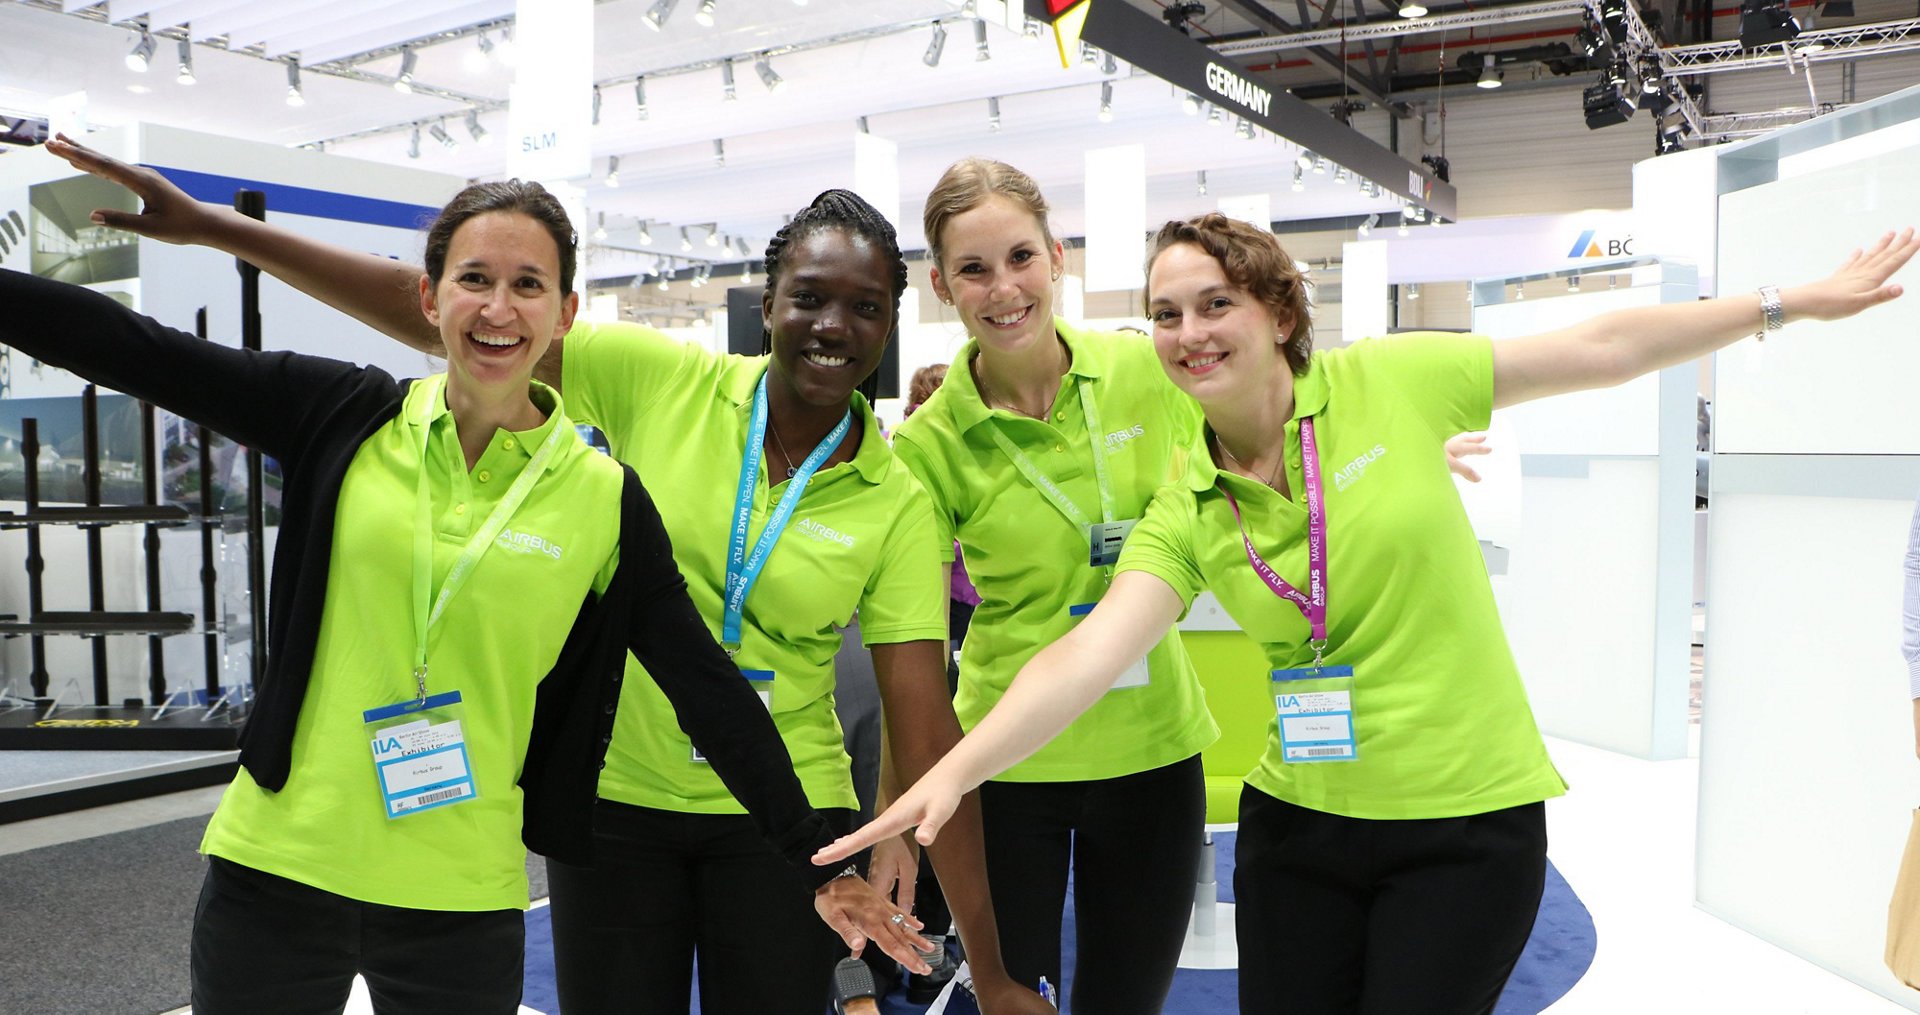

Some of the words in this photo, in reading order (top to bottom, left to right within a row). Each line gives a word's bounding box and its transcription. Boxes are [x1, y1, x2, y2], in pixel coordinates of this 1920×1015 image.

[1206, 62, 1271, 117] GERMANY
[523, 132, 556, 152] SLM
[1104, 424, 1145, 448] IRBUS
[1303, 444, 1311, 453] IT
[1304, 454, 1315, 477] MAKE
[1334, 444, 1386, 485] AIRBUS
[730, 576, 748, 612] AIRBUS
[746, 547, 763, 571] MAKE
[759, 538, 767, 548] IT
[827, 423, 845, 444] MAKE
[737, 507, 748, 534] MAKE
[736, 535, 744, 545] IT
[799, 517, 854, 547] AIRBUS
[1311, 526, 1319, 535] IT
[499, 529, 562, 559] AIRBUS
[733, 546, 743, 564] FLY.
[1311, 535, 1319, 561] MAKE
[1260, 564, 1270, 573] IT
[1268, 572, 1283, 588] FLY.
[1311, 569, 1320, 606] AIRBUS
[1277, 695, 1300, 708] ILA
[373, 737, 403, 755] ILA
[401, 742, 446, 757] Exhibitor
